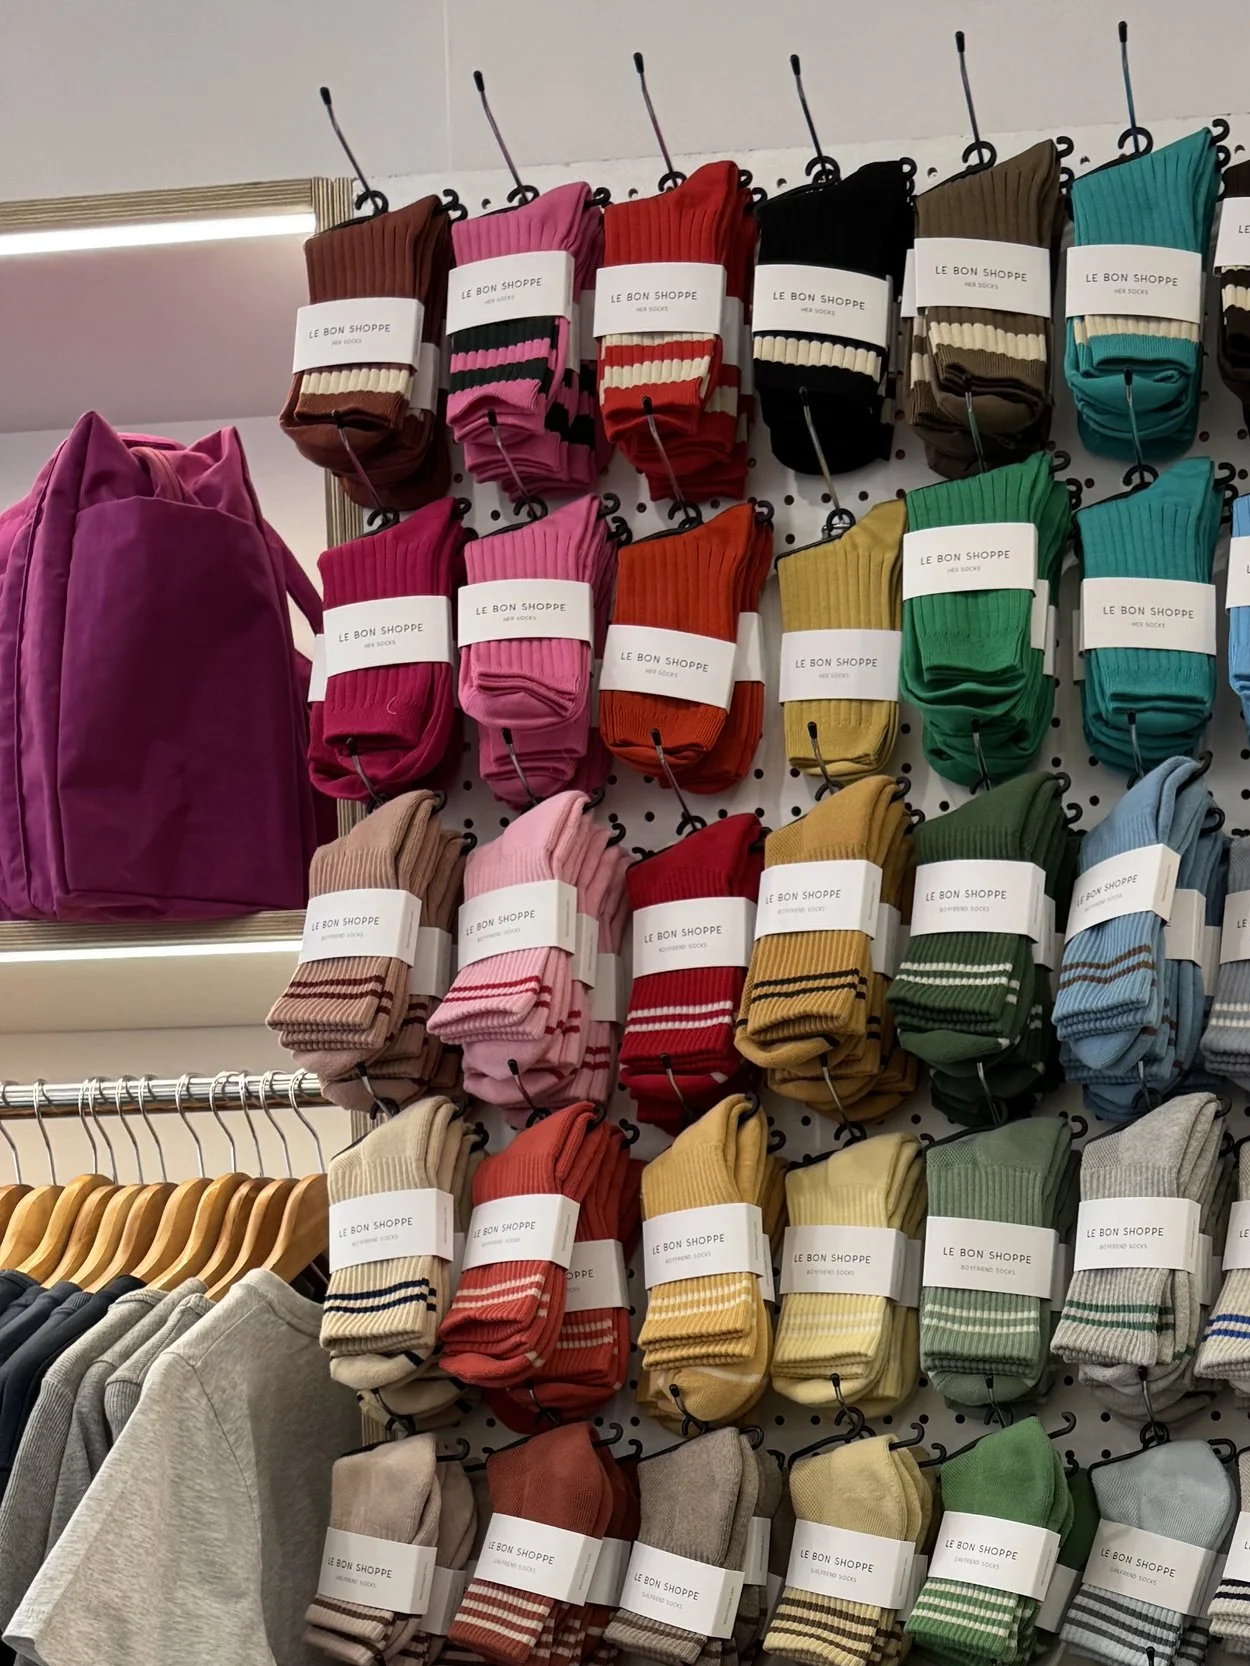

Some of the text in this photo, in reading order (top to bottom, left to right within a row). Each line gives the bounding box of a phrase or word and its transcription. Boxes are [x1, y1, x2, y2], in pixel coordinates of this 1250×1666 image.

[1239, 225, 1250, 233] LE
[309, 324, 390, 338] LE BON SHOPPE
[476, 603, 565, 615] LE BON SHOPPE
[645, 926, 721, 943] LE BON SHOPPE
[801, 1550, 873, 1573] LE BON SHOPPE
